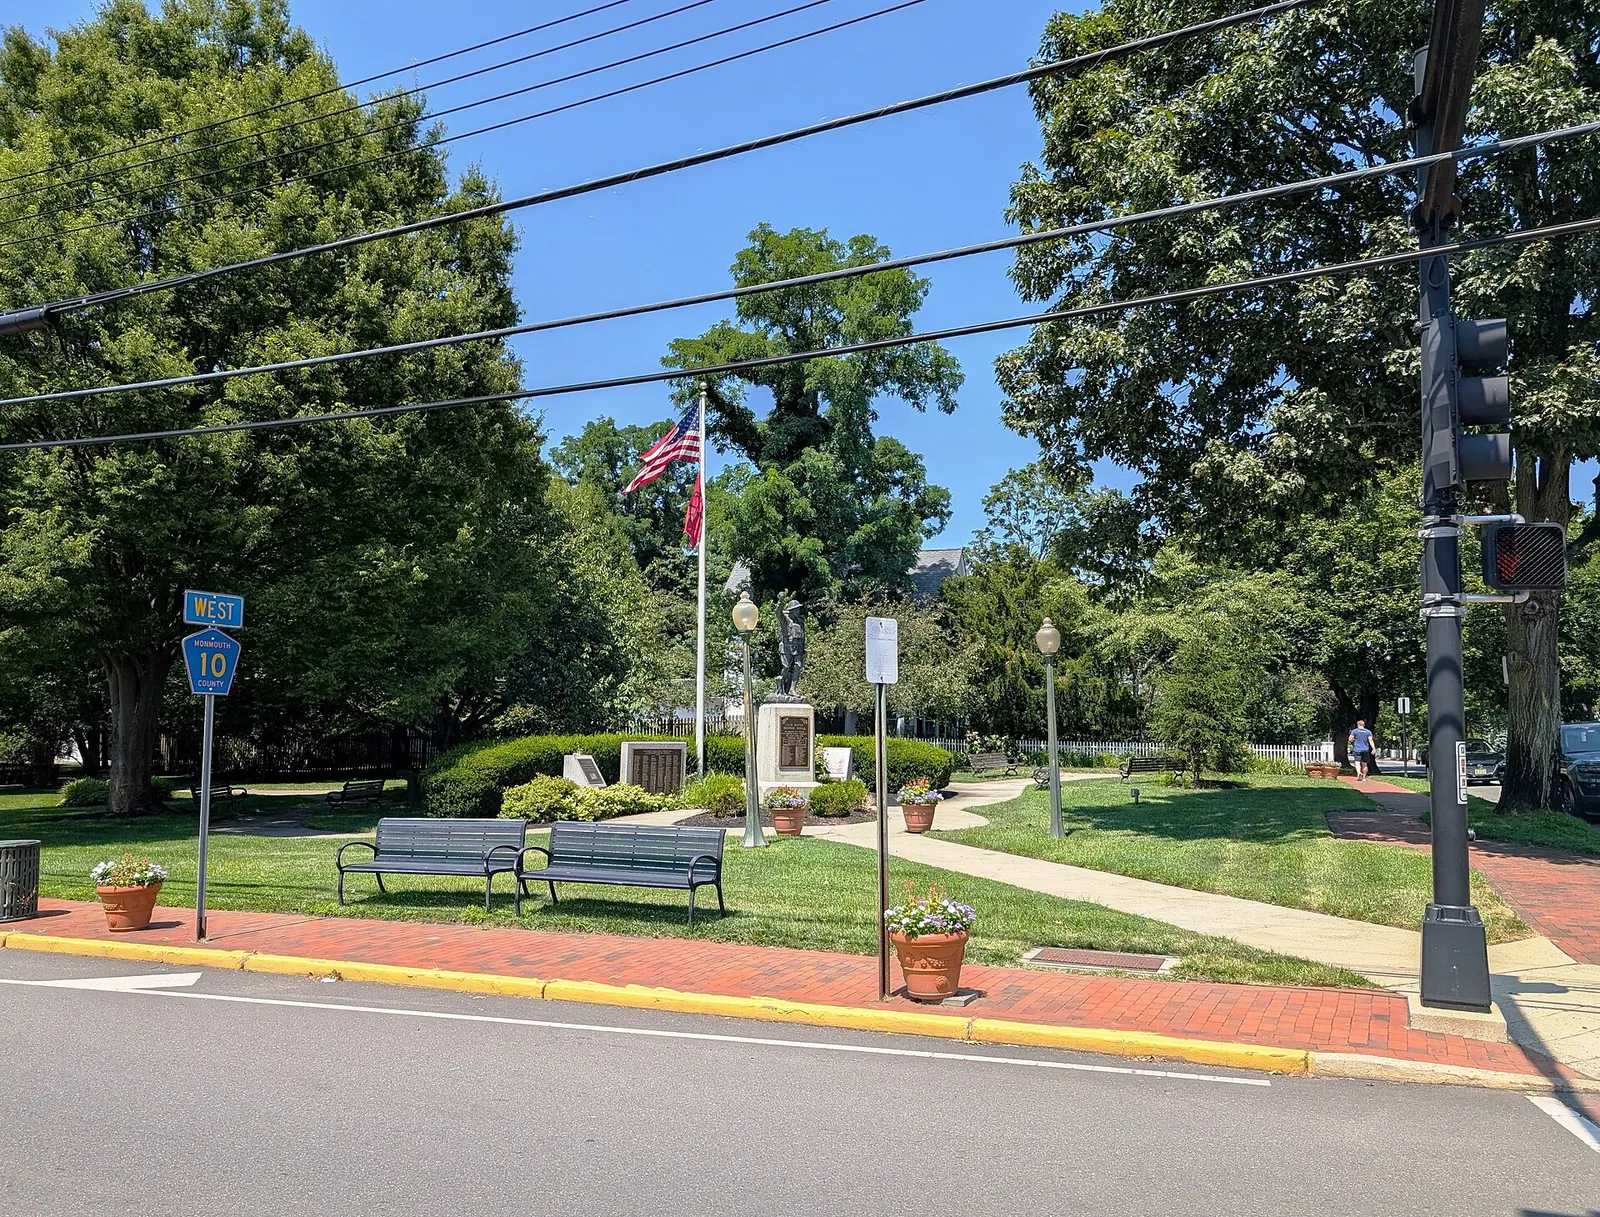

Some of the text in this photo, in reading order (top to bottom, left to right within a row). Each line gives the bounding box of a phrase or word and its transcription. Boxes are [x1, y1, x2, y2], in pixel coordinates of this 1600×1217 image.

[194, 597, 234, 620] WEST
[194, 640, 231, 649] MONMOUTH
[200, 652, 226, 678] 10
